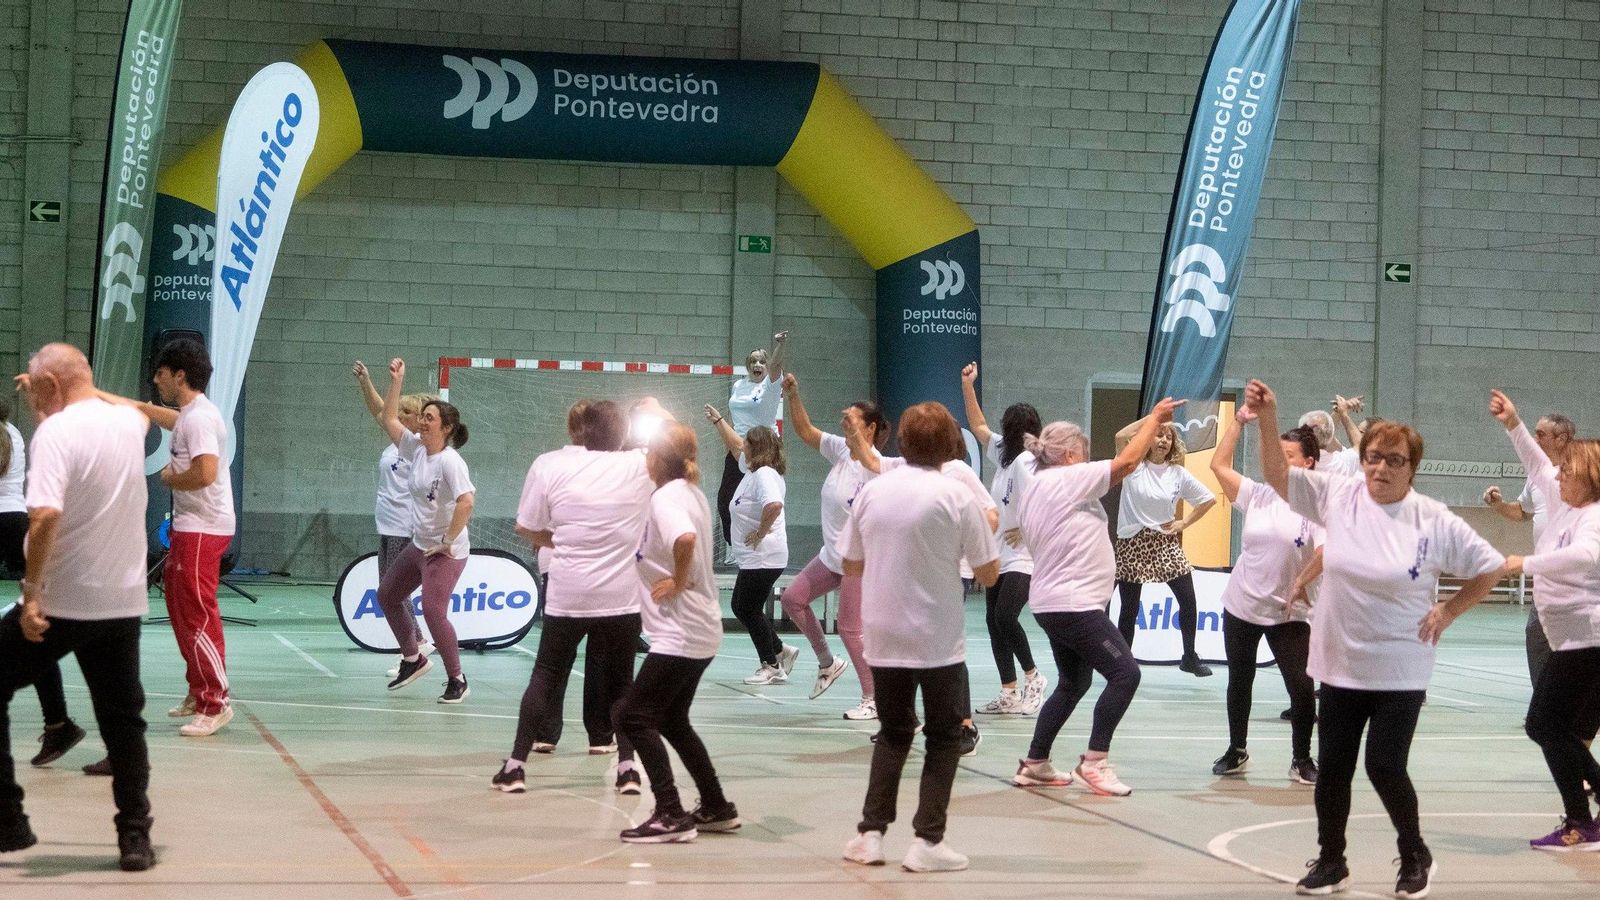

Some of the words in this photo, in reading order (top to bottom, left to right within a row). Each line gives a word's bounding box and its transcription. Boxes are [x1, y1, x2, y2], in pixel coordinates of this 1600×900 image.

[117, 30, 150, 205] Deputación
[130, 36, 164, 209] Pontevedra
[554, 68, 718, 97] Deputación
[554, 94, 718, 124] Pontevedra
[1188, 66, 1244, 228] Deputación
[1209, 70, 1267, 233] Pontevedra
[219, 92, 303, 312] Atlántico
[903, 308, 977, 323] Deputación
[903, 322, 977, 336] Pontevedra
[352, 582, 532, 620] Antico
